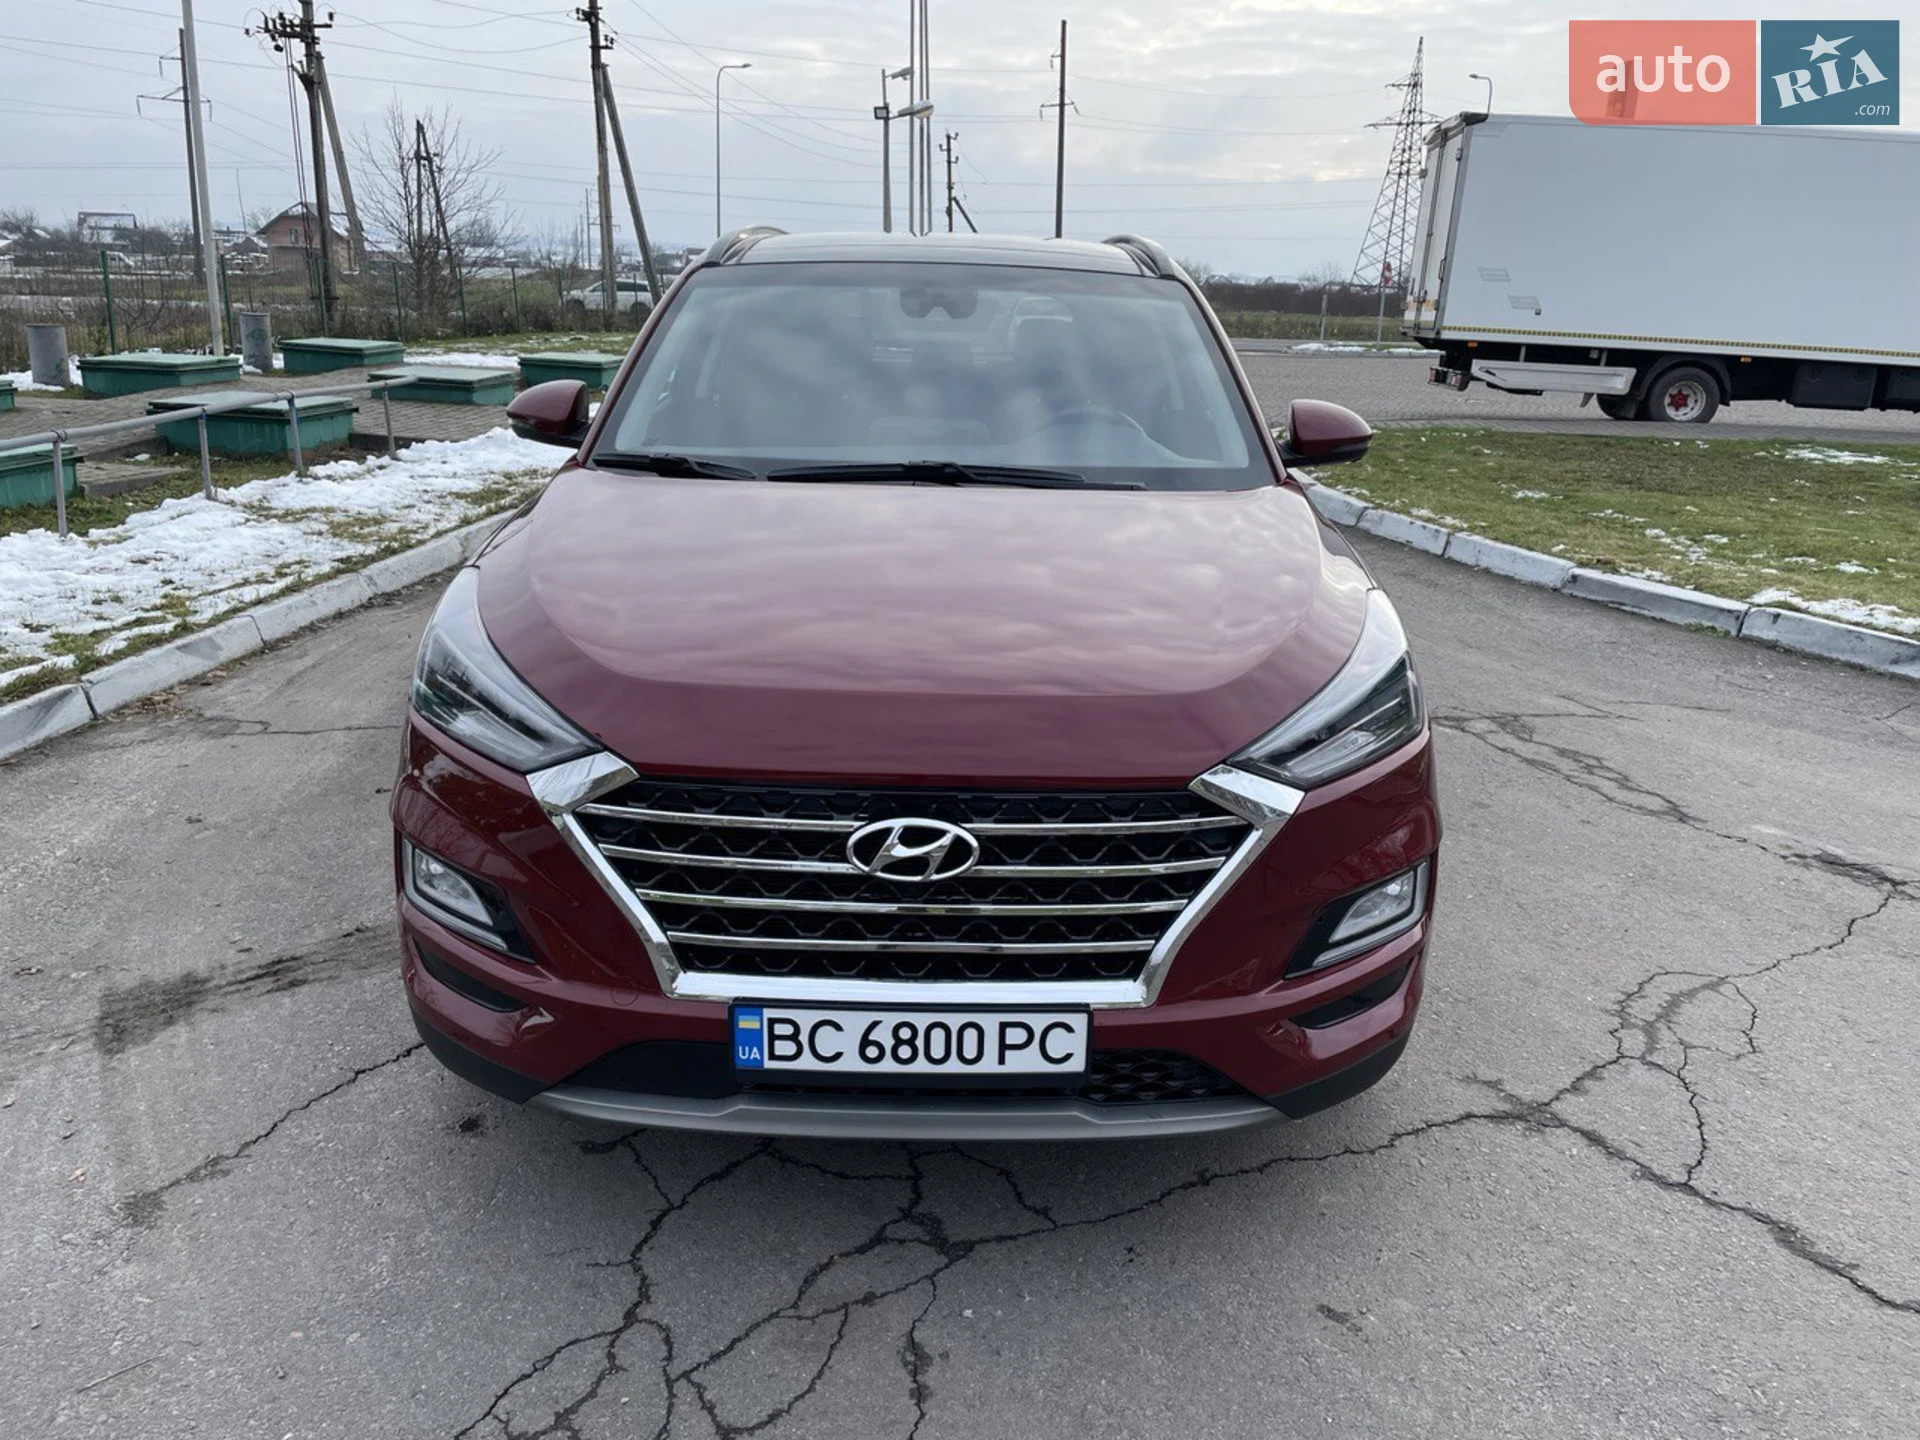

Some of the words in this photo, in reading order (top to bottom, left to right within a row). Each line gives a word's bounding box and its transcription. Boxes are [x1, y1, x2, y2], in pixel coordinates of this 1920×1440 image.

[738, 1046, 761, 1060] UA
[766, 1017, 845, 1063] BC
[858, 1020, 985, 1066] 6800
[997, 1021, 1076, 1066] PC
